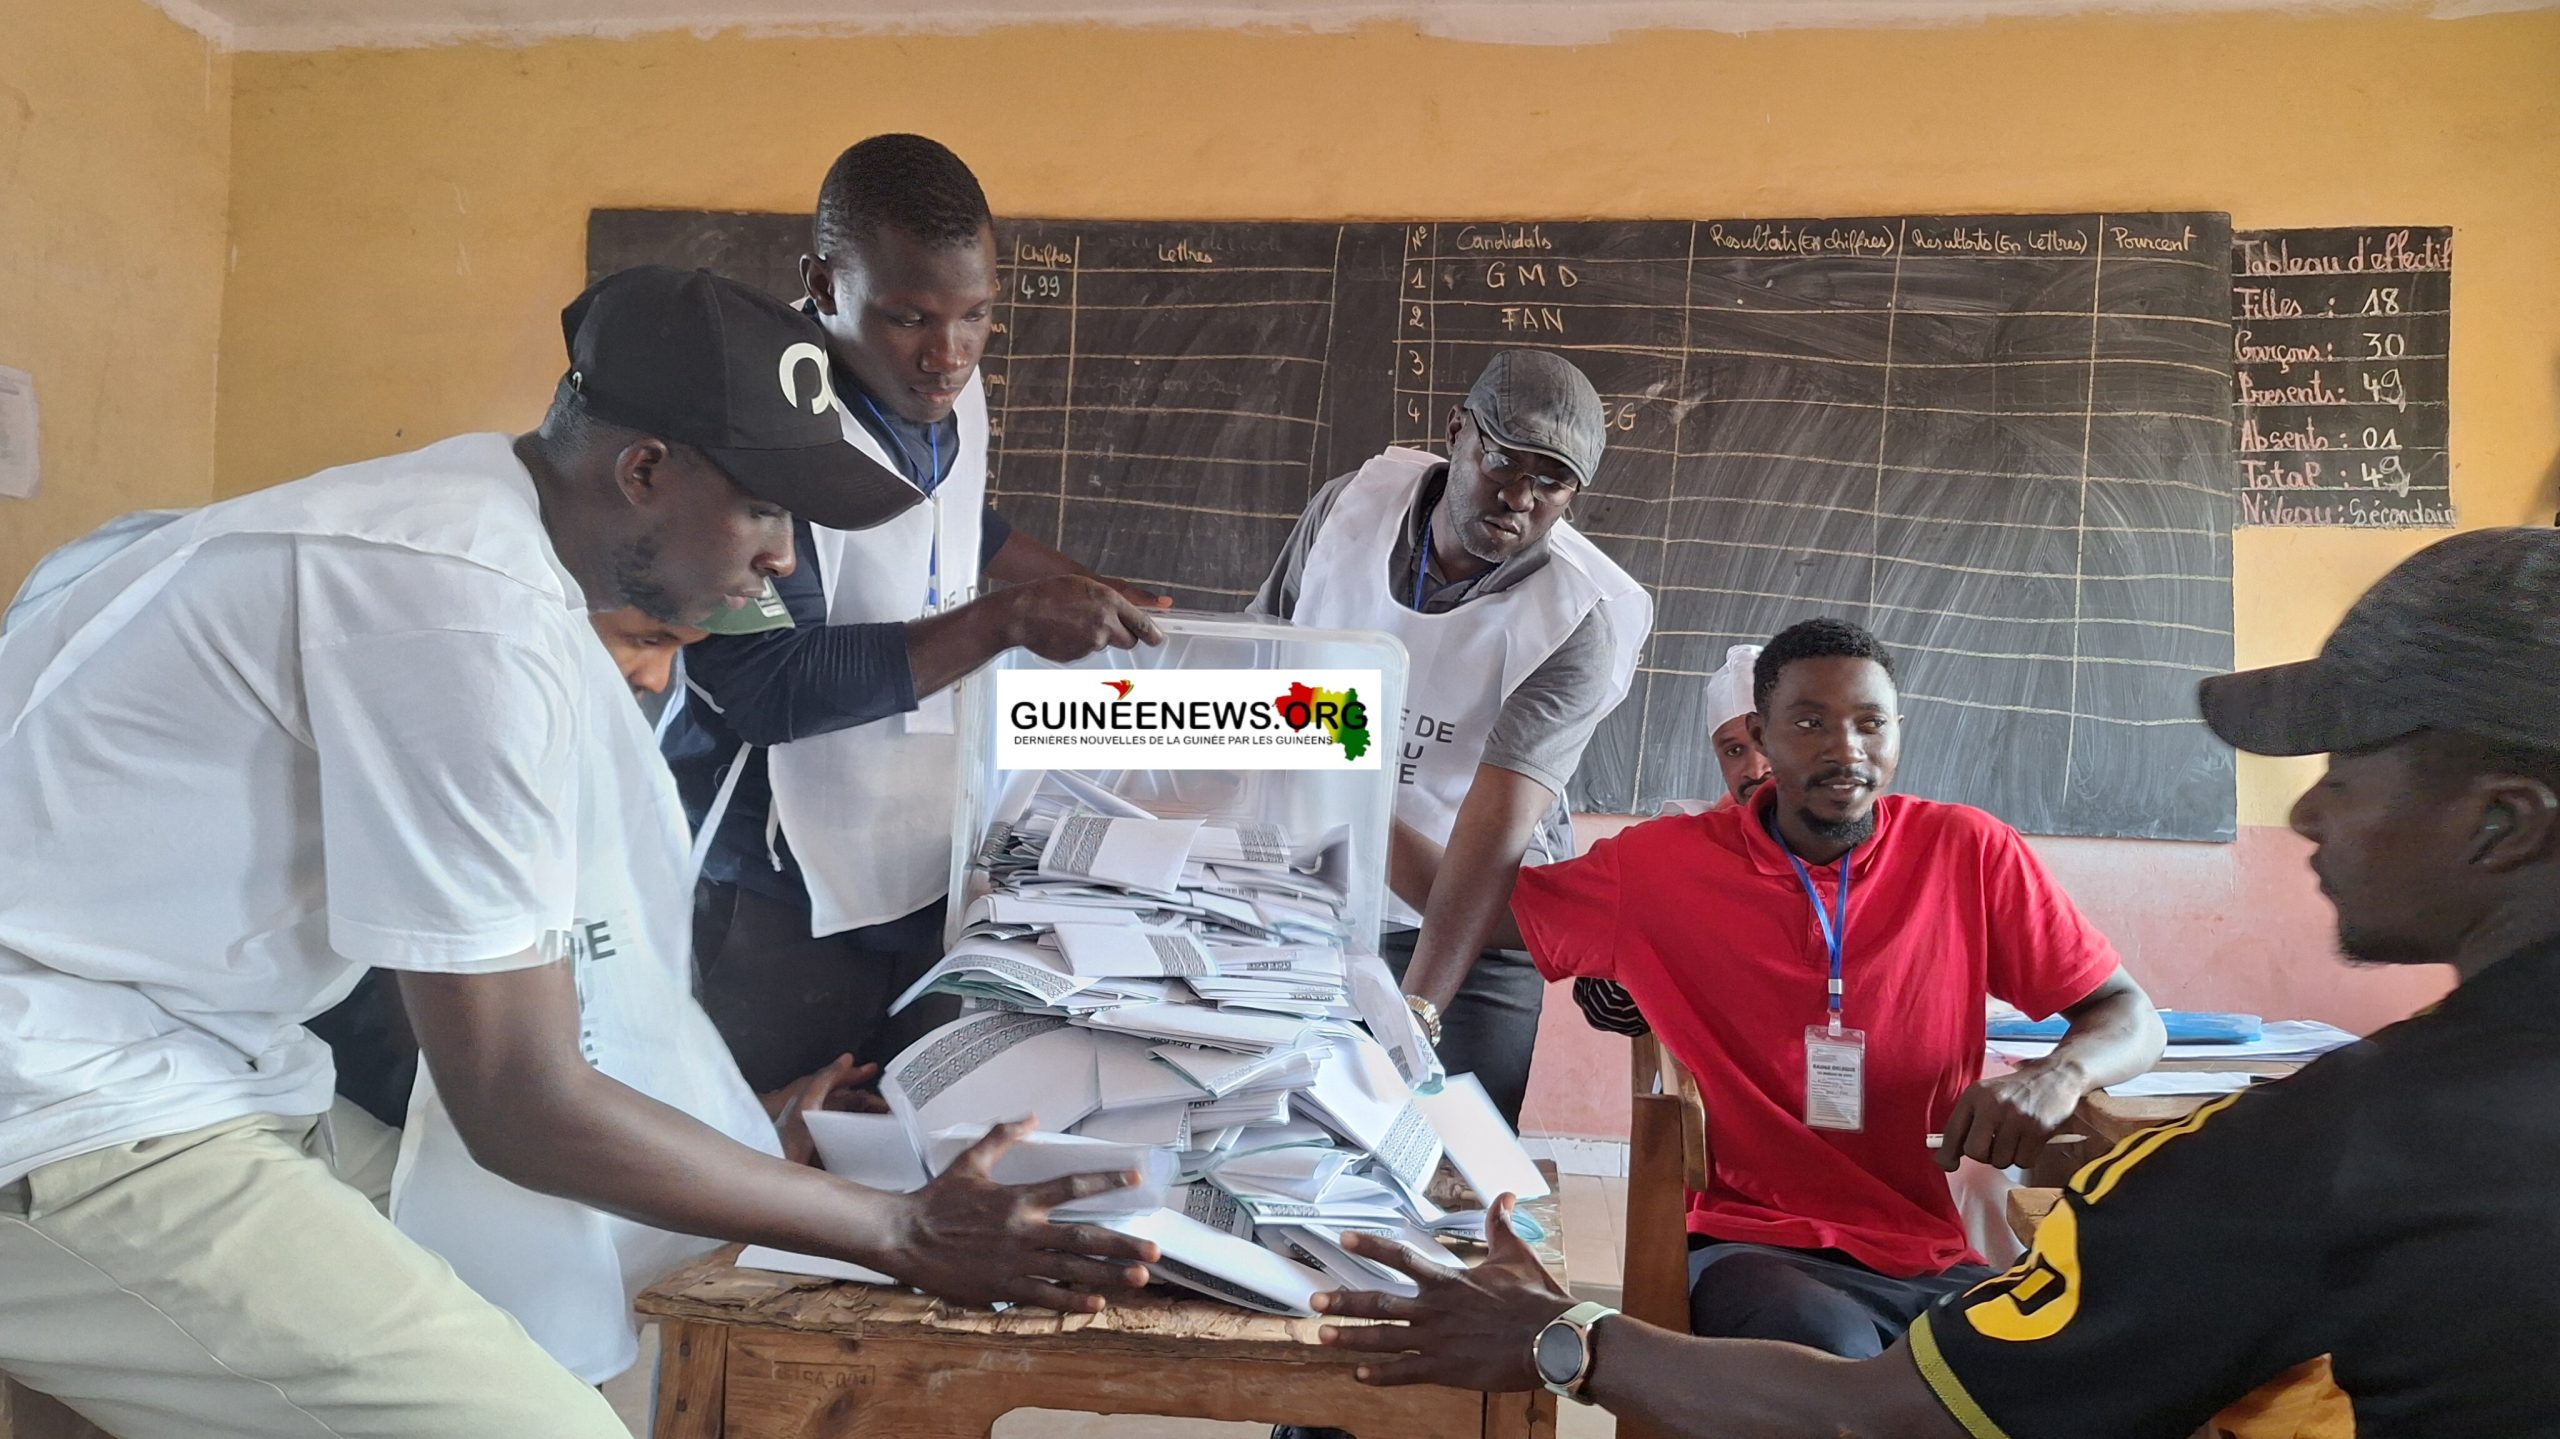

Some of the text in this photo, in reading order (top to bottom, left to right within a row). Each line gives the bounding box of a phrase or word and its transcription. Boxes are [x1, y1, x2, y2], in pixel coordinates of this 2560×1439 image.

[1456, 225, 1552, 251] Candidats
[2110, 225, 2197, 251] Pourcent
[2231, 239, 2340, 276] Tableau
[1021, 274, 1061, 299] 499
[1411, 267, 1427, 289] 1
[2233, 287, 2302, 318] Filles
[2361, 288, 2400, 316] 18
[1411, 306, 1424, 329] 2
[1501, 308, 1565, 333] FAN
[2363, 333, 2405, 360] 30
[1411, 351, 1425, 376] 3
[1407, 399, 1420, 424] 4
[2240, 416, 2329, 451] Absents
[2240, 459, 2321, 490] Total
[1414, 714, 1456, 744] DE
